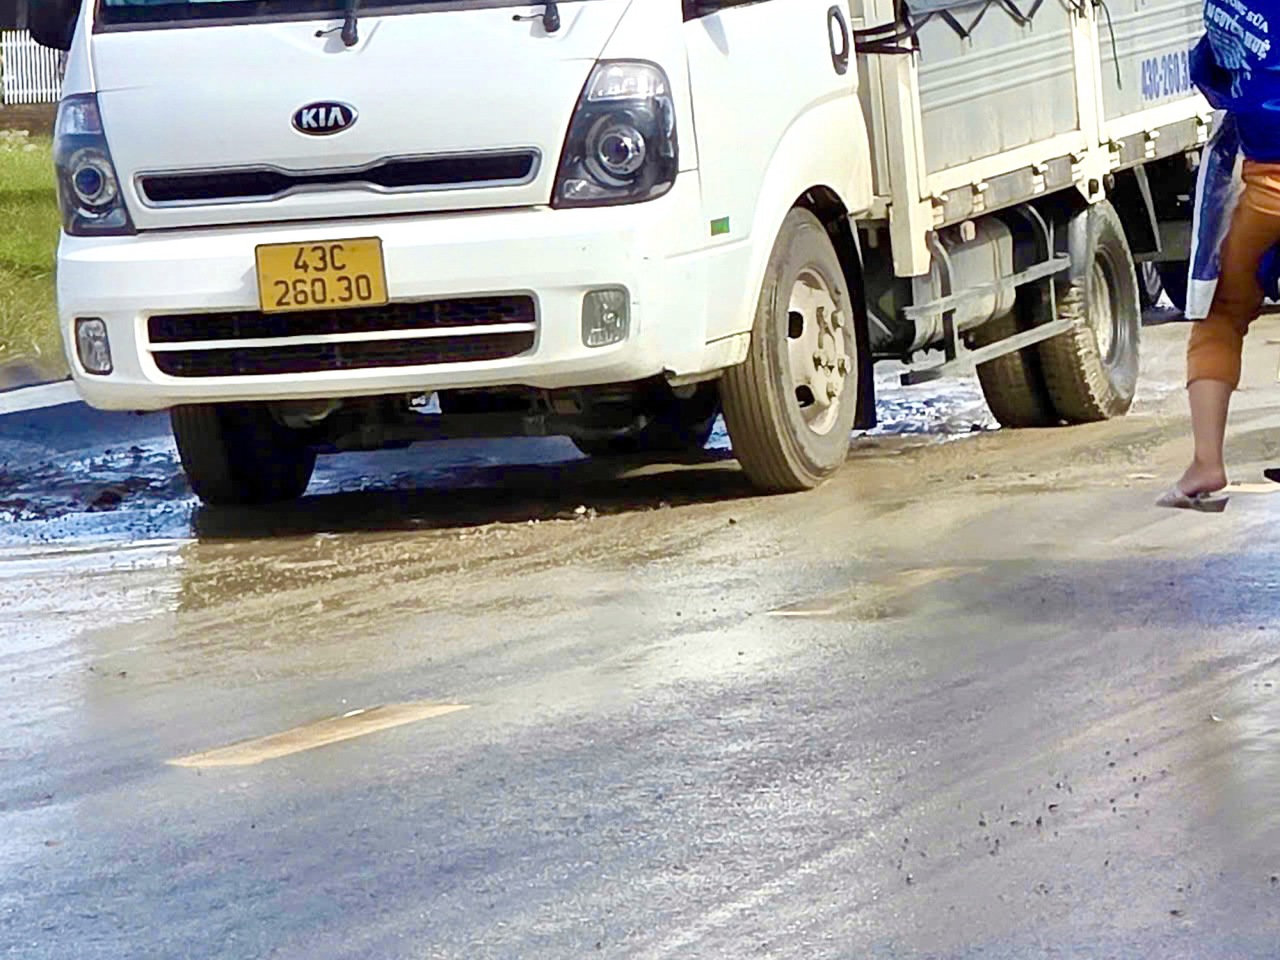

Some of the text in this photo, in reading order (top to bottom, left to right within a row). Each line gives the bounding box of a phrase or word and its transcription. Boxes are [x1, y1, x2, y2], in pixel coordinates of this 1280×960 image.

[302, 107, 346, 129] KIA
[293, 244, 346, 273] 43C
[274, 274, 372, 307] 260.30
